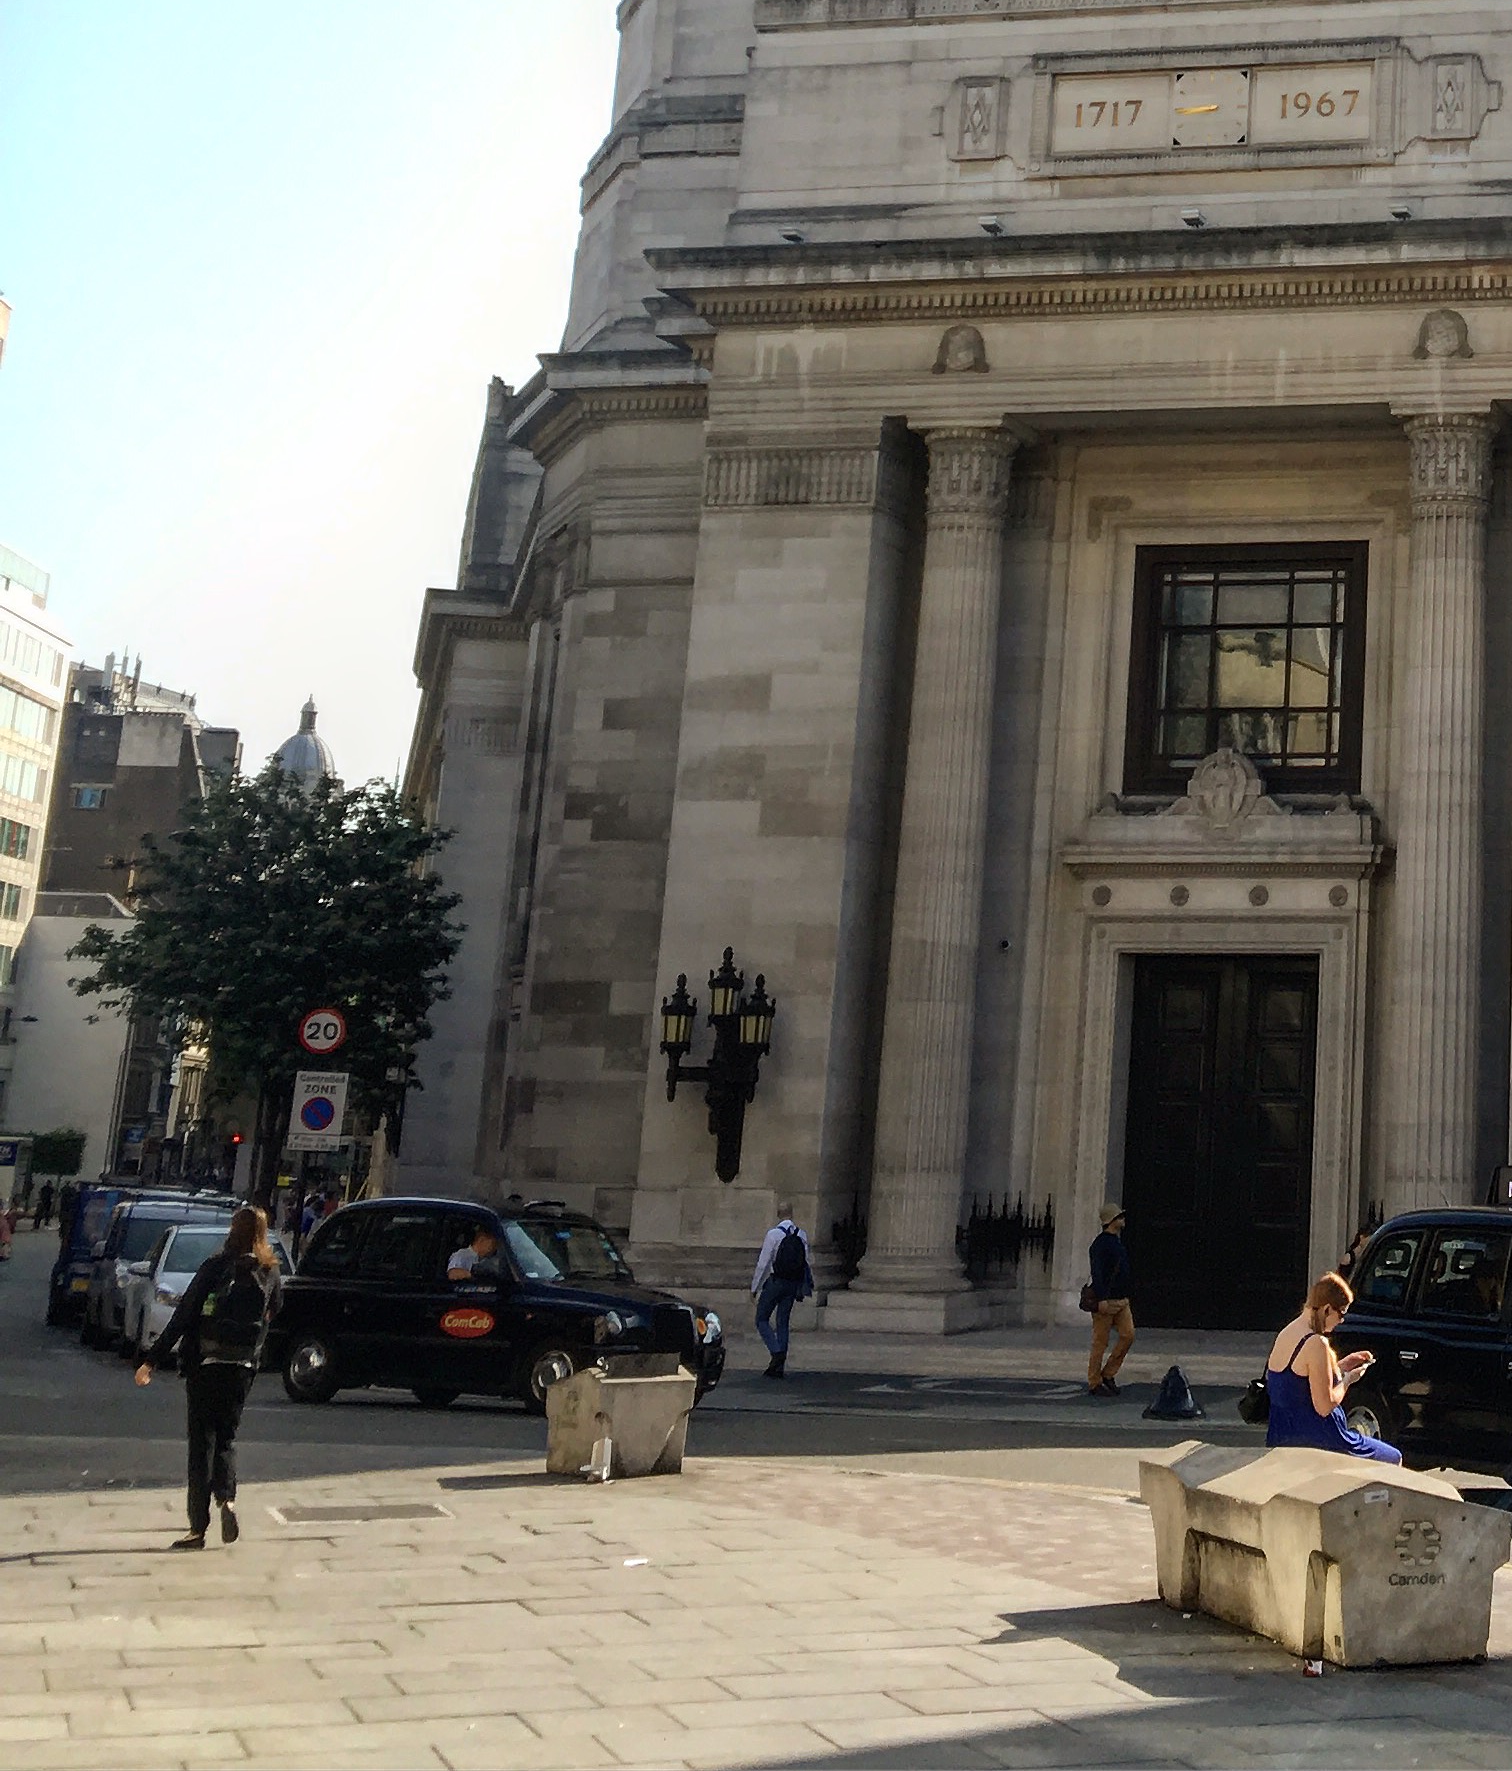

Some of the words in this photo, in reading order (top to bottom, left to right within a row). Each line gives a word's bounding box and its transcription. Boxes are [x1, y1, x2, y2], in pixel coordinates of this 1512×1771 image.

[1280, 89, 1360, 119] 1967
[1074, 100, 1143, 128] 1717
[306, 1022, 339, 1040] 20
[304, 1084, 337, 1095] ZONE
[445, 1314, 490, 1329] ComCab
[1388, 1572, 1446, 1587] Camden
